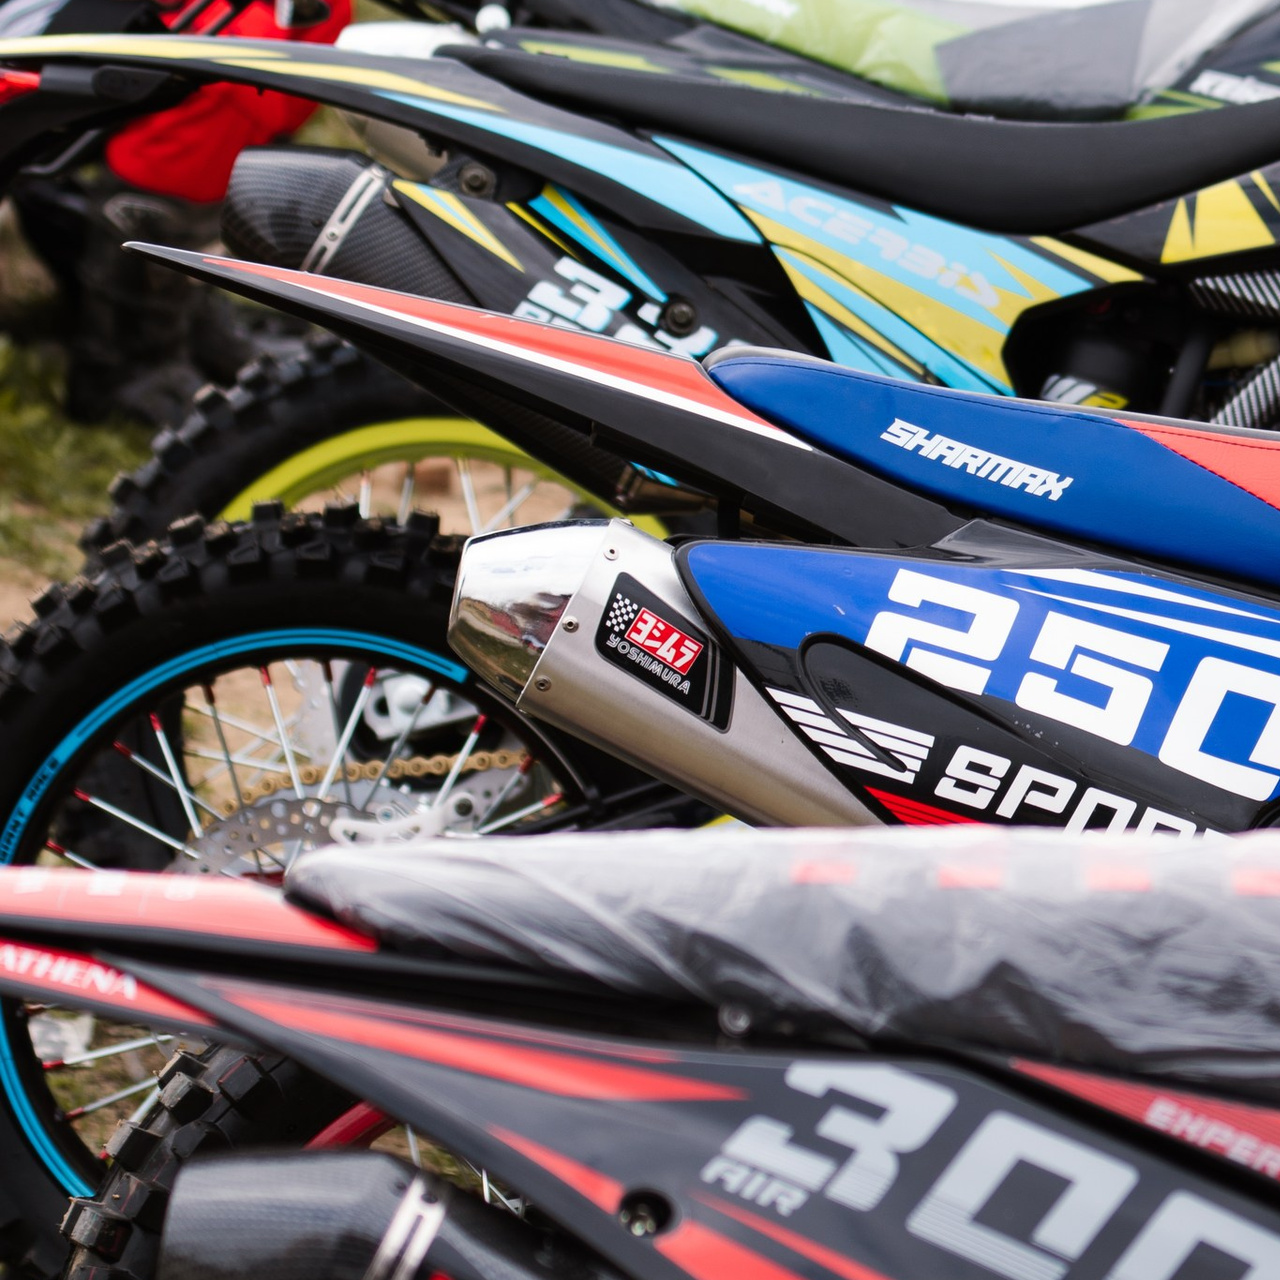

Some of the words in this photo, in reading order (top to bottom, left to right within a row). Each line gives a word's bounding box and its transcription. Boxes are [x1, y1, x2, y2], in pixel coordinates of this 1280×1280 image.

[880, 418, 1074, 501] SHARMAX
[605, 633, 691, 696] YOSHIMURA
[629, 611, 699, 669] ヨシムラ
[701, 1156, 809, 1217] AIR
